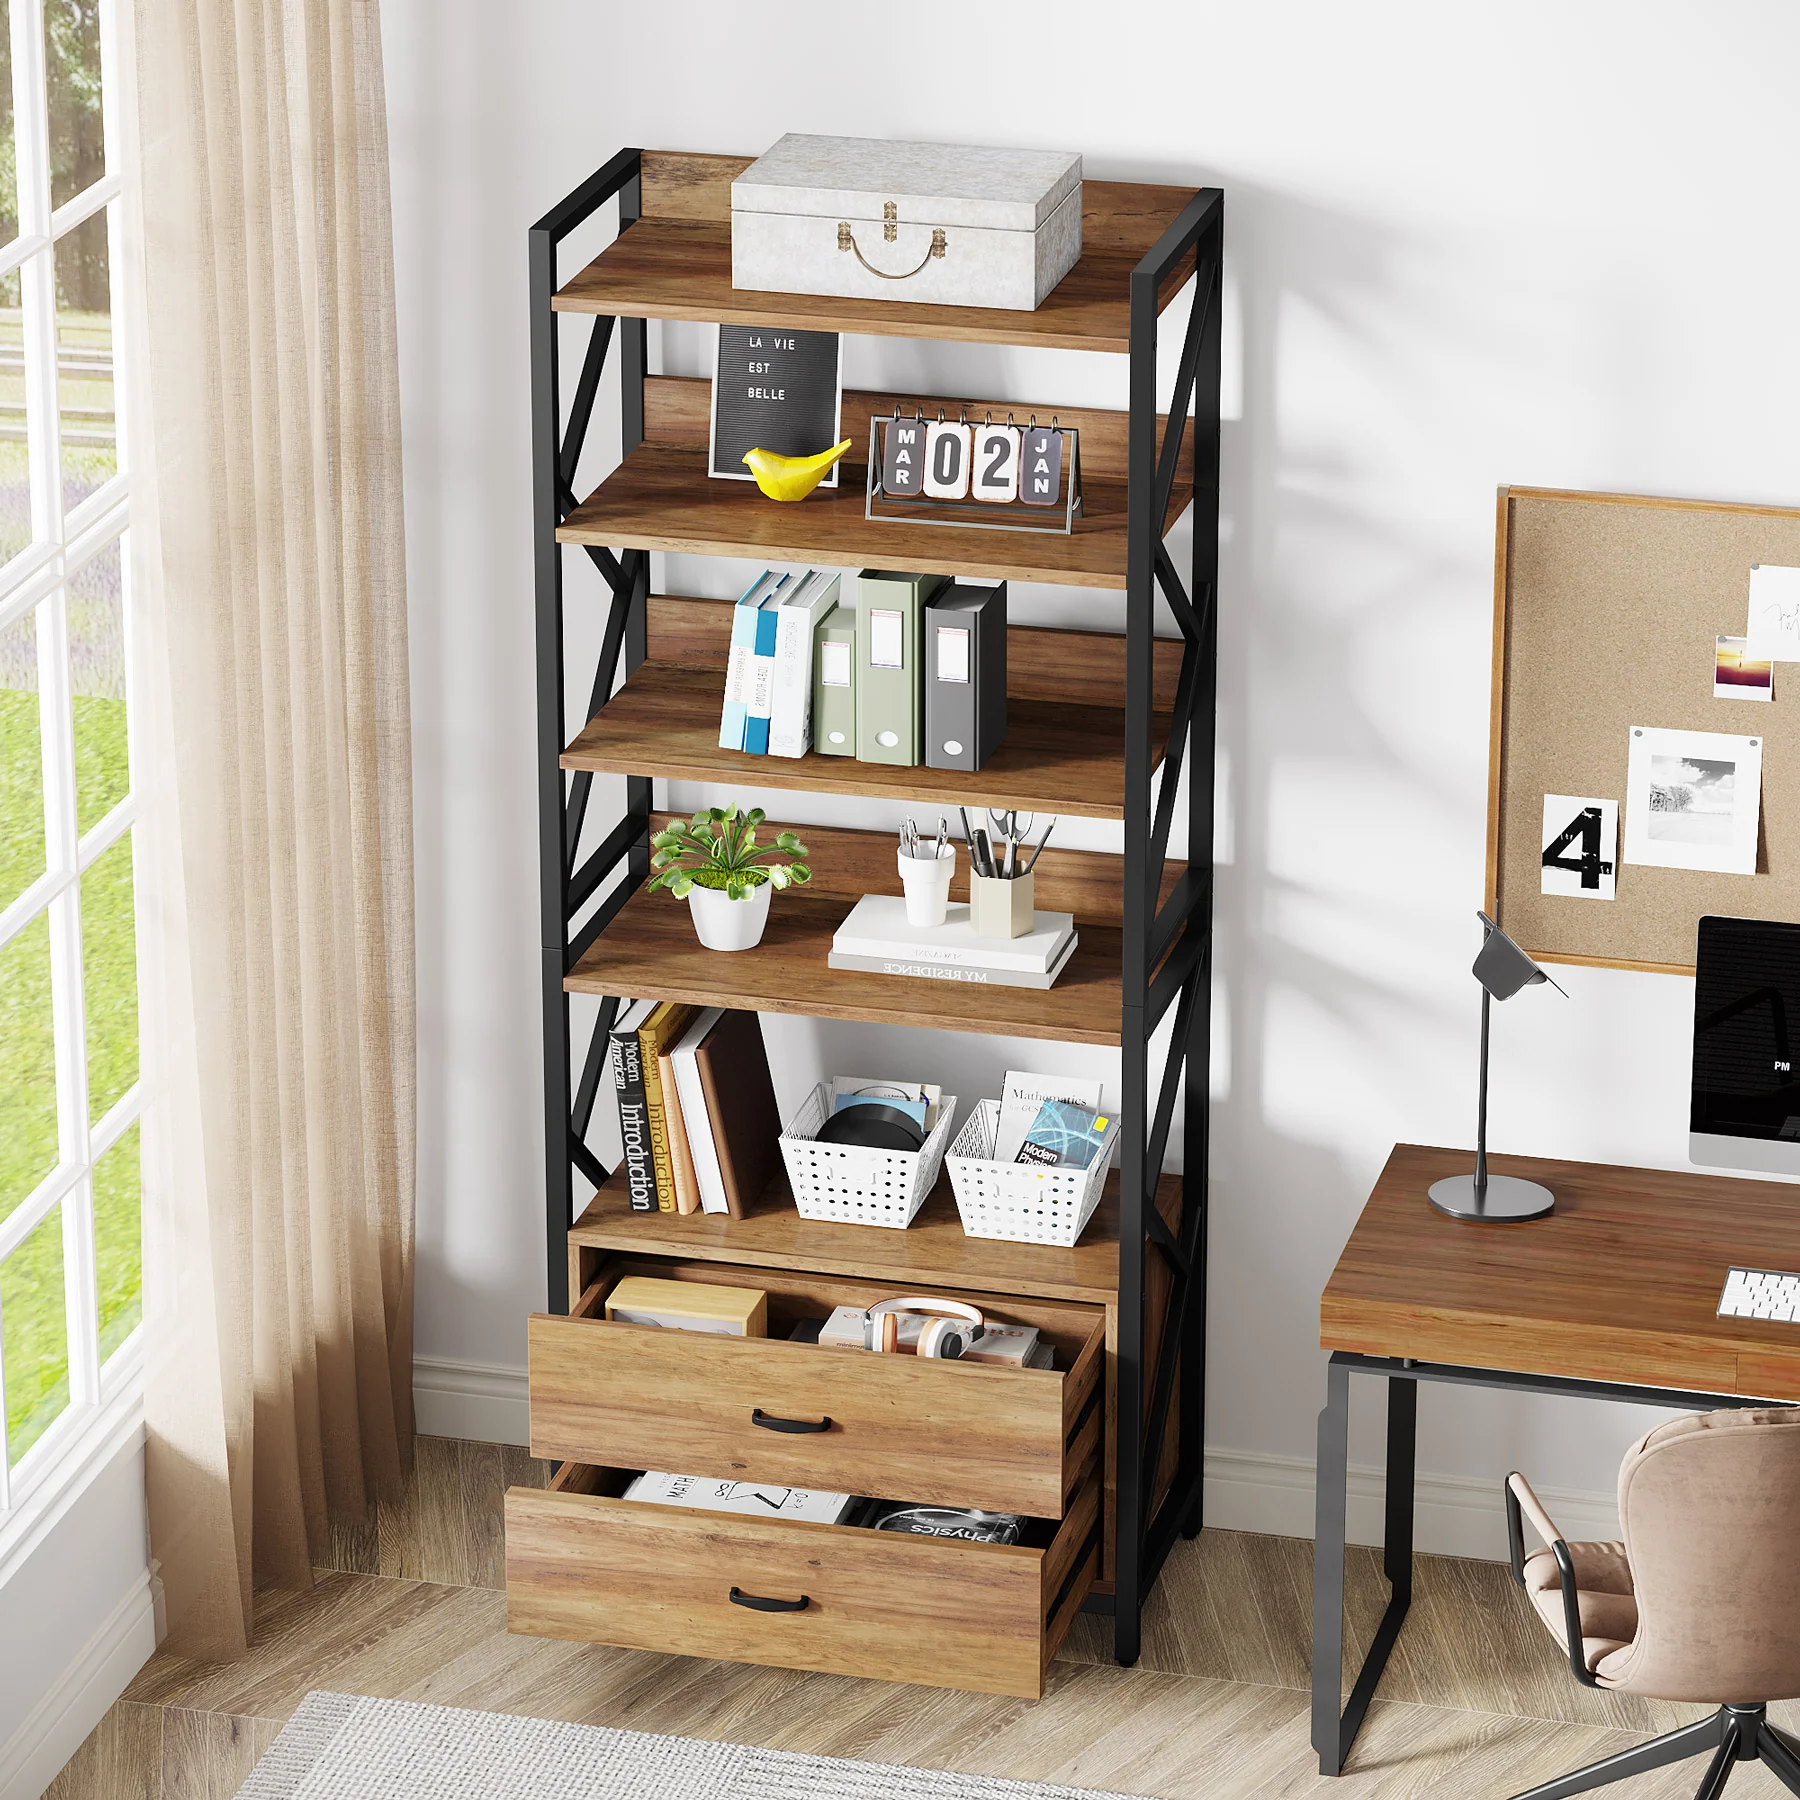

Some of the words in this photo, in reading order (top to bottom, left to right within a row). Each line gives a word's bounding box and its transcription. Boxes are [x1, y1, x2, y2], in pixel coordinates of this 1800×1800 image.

[749, 337, 762, 347] LA
[774, 338, 795, 350] VIE
[748, 363, 770, 373] EST
[748, 388, 785, 400] BELLE
[895, 429, 915, 485] MAR
[1033, 438, 1050, 494] JAN
[1542, 807, 1612, 889] 4
[610, 1035, 627, 1090] American
[624, 1041, 640, 1082] Modern
[639, 1035, 651, 1088] American
[648, 1040, 660, 1080] Modern
[1774, 1061, 1790, 1071] PM
[621, 1102, 653, 1210] Introduction
[649, 1103, 672, 1210] Introduction
[1023, 1143, 1057, 1163] Modern
[666, 1477, 695, 1499] MATH
[910, 1524, 993, 1543] Physics
